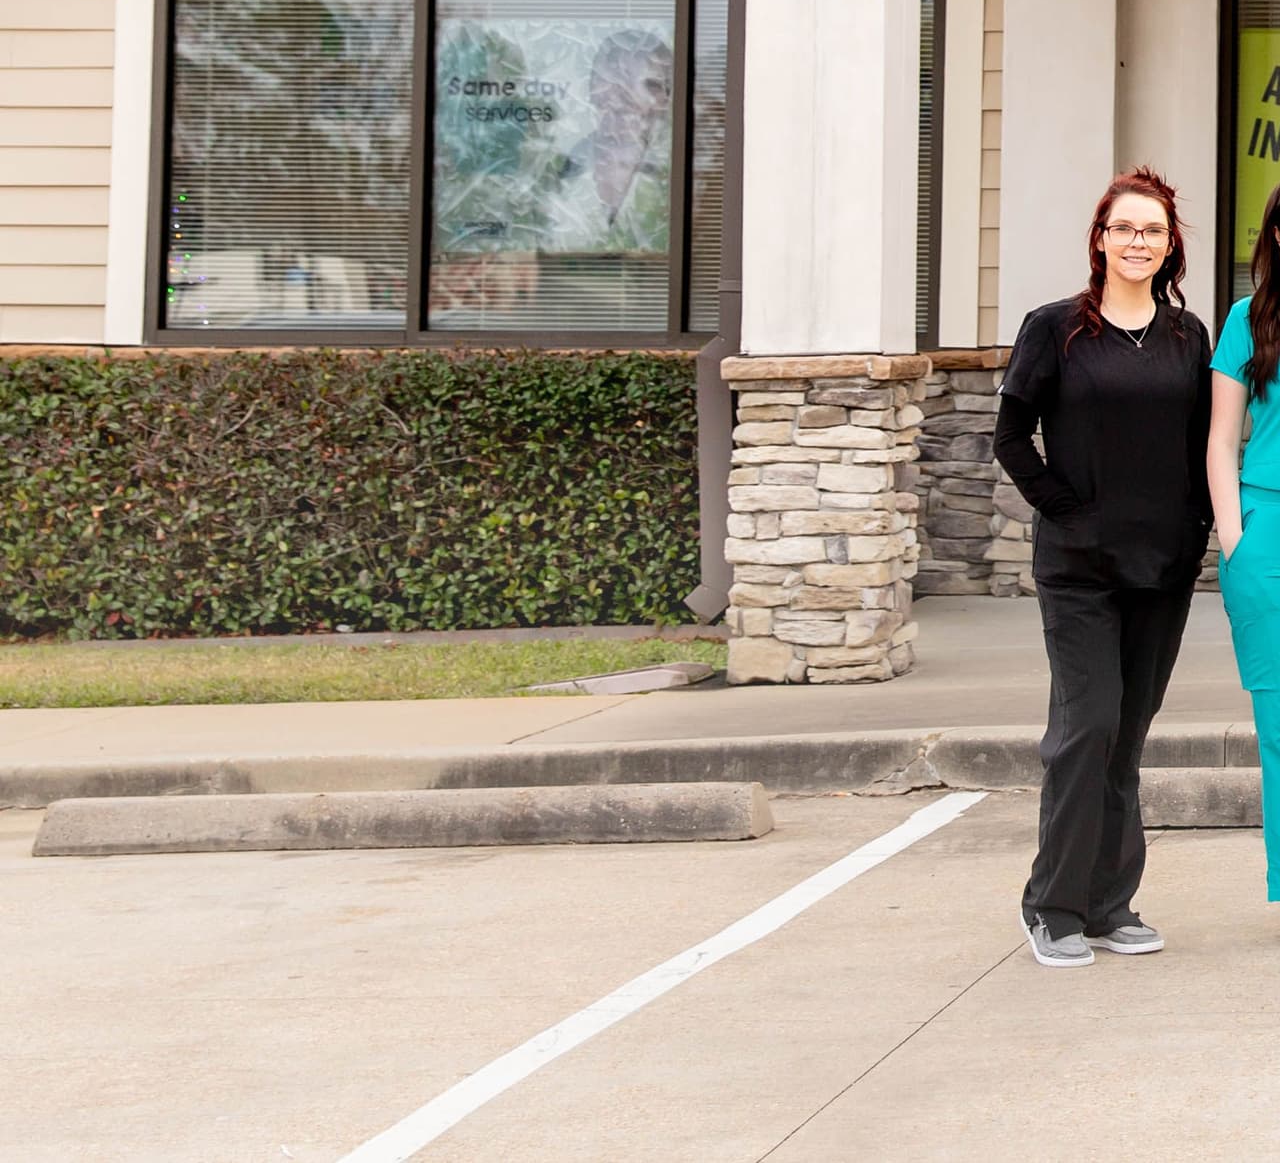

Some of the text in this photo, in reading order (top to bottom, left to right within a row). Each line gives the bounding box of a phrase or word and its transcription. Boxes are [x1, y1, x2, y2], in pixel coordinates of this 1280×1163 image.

[447, 76, 571, 100] Same day
[465, 103, 553, 123] services
